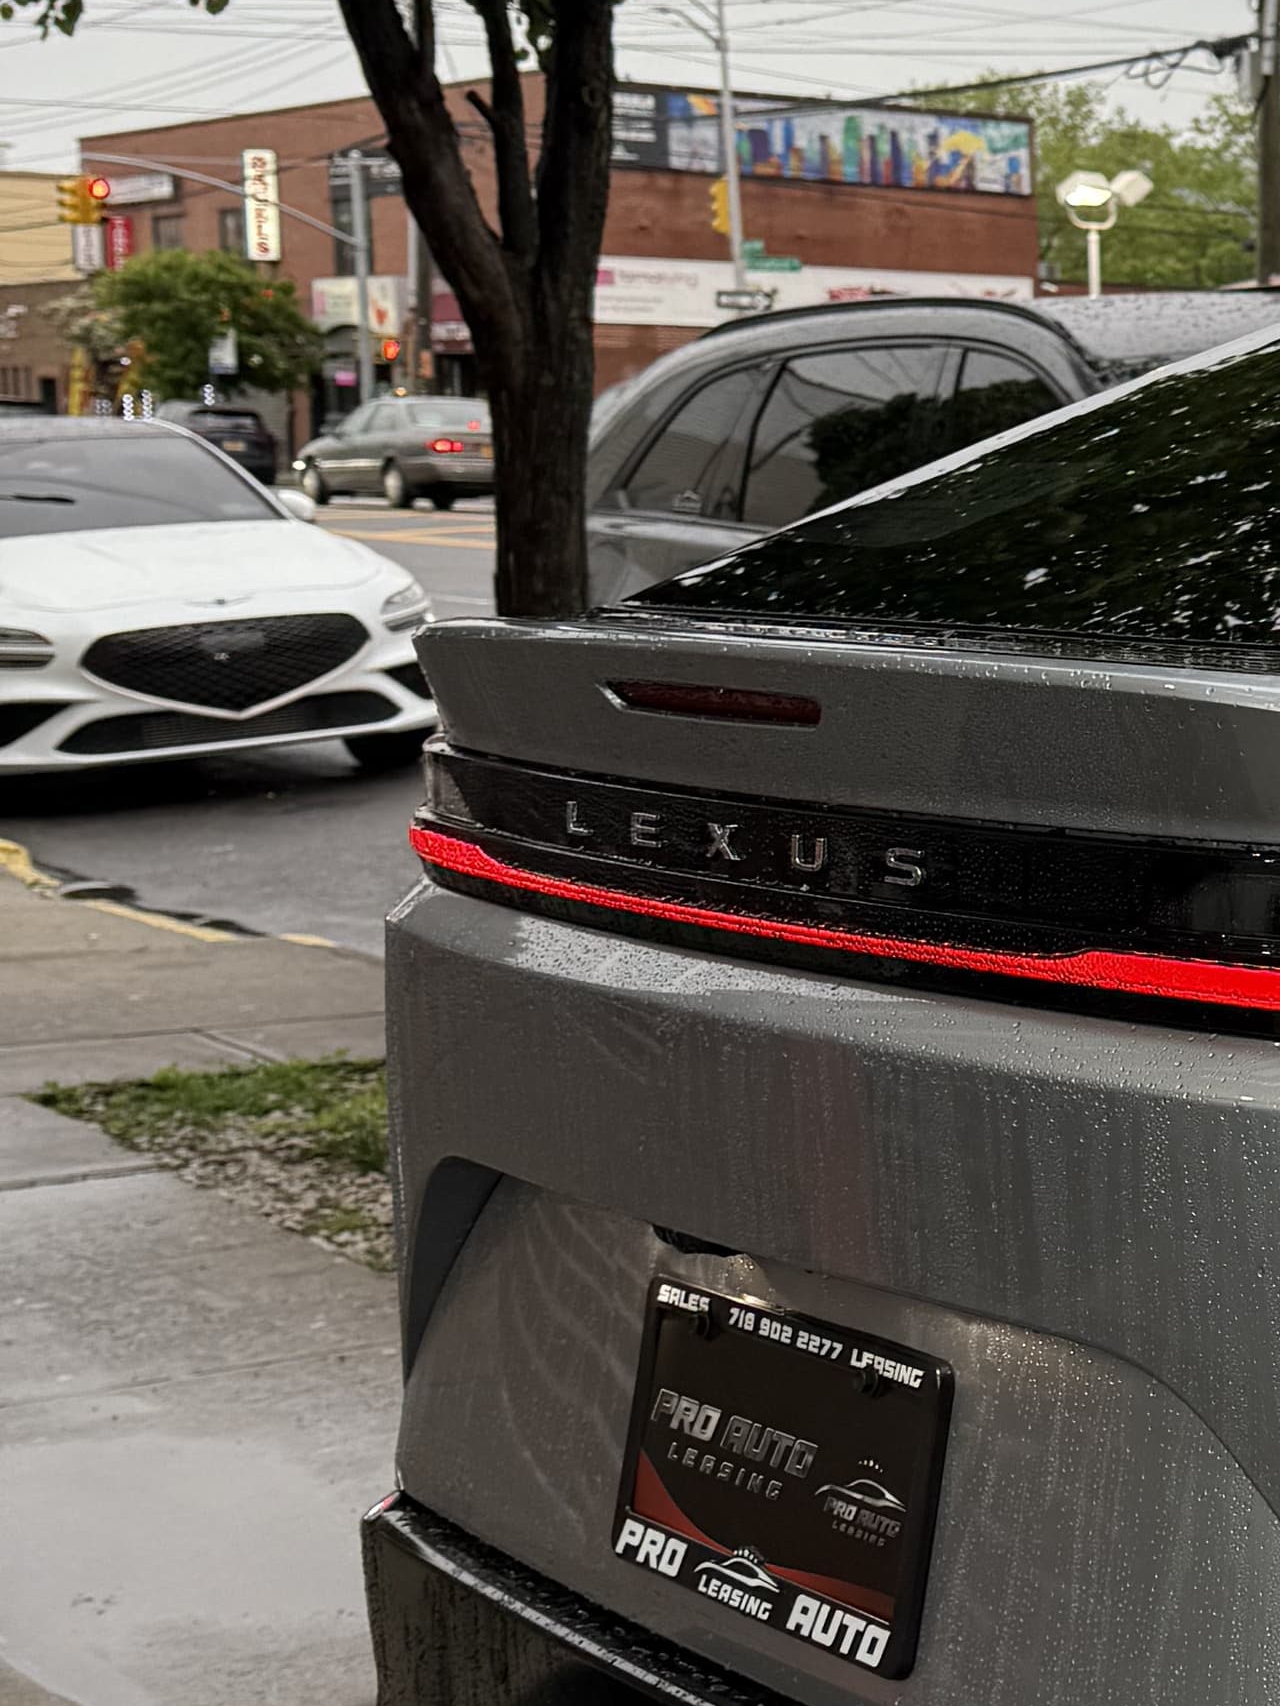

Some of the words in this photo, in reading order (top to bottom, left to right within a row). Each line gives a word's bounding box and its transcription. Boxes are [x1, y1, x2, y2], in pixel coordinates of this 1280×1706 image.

[564, 800, 923, 887] LEXUS
[656, 1283, 711, 1313] SALES
[728, 1306, 756, 1332] 718
[758, 1316, 793, 1345] 902
[795, 1329, 844, 1361] 2277
[849, 1347, 926, 1389] LEASING
[650, 1388, 723, 1442] PRO
[719, 1414, 819, 1479] AUTO
[666, 1441, 785, 1501] LEASING
[823, 1495, 858, 1522] PRO
[856, 1508, 902, 1539] AUTO
[615, 1517, 688, 1577] PRO
[697, 1573, 774, 1622] LEASING
[785, 1593, 892, 1669] AUTO
